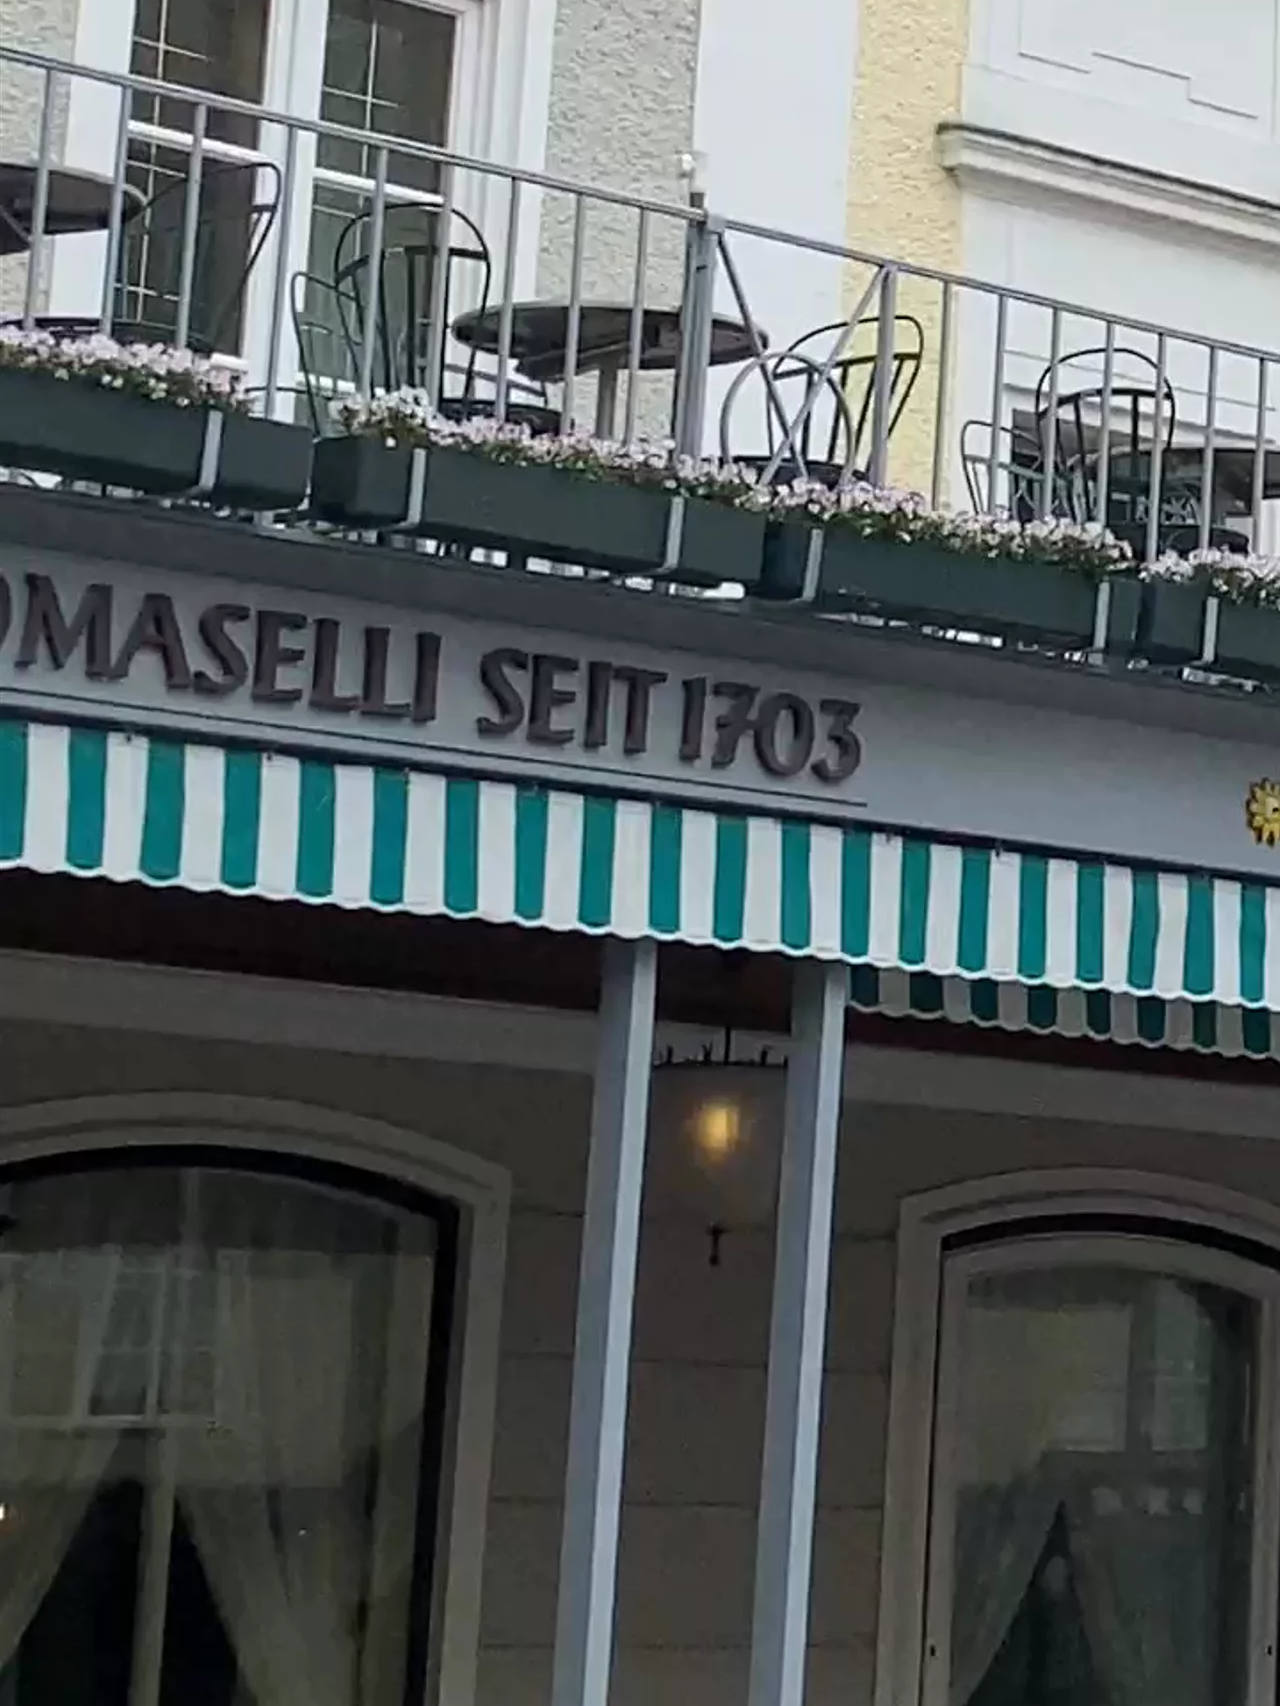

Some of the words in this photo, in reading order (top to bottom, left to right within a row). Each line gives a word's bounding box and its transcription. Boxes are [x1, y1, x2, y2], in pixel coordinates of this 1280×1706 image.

[0, 571, 443, 724] MASELLI
[477, 647, 668, 755] SEIT
[680, 674, 863, 783] 1703
